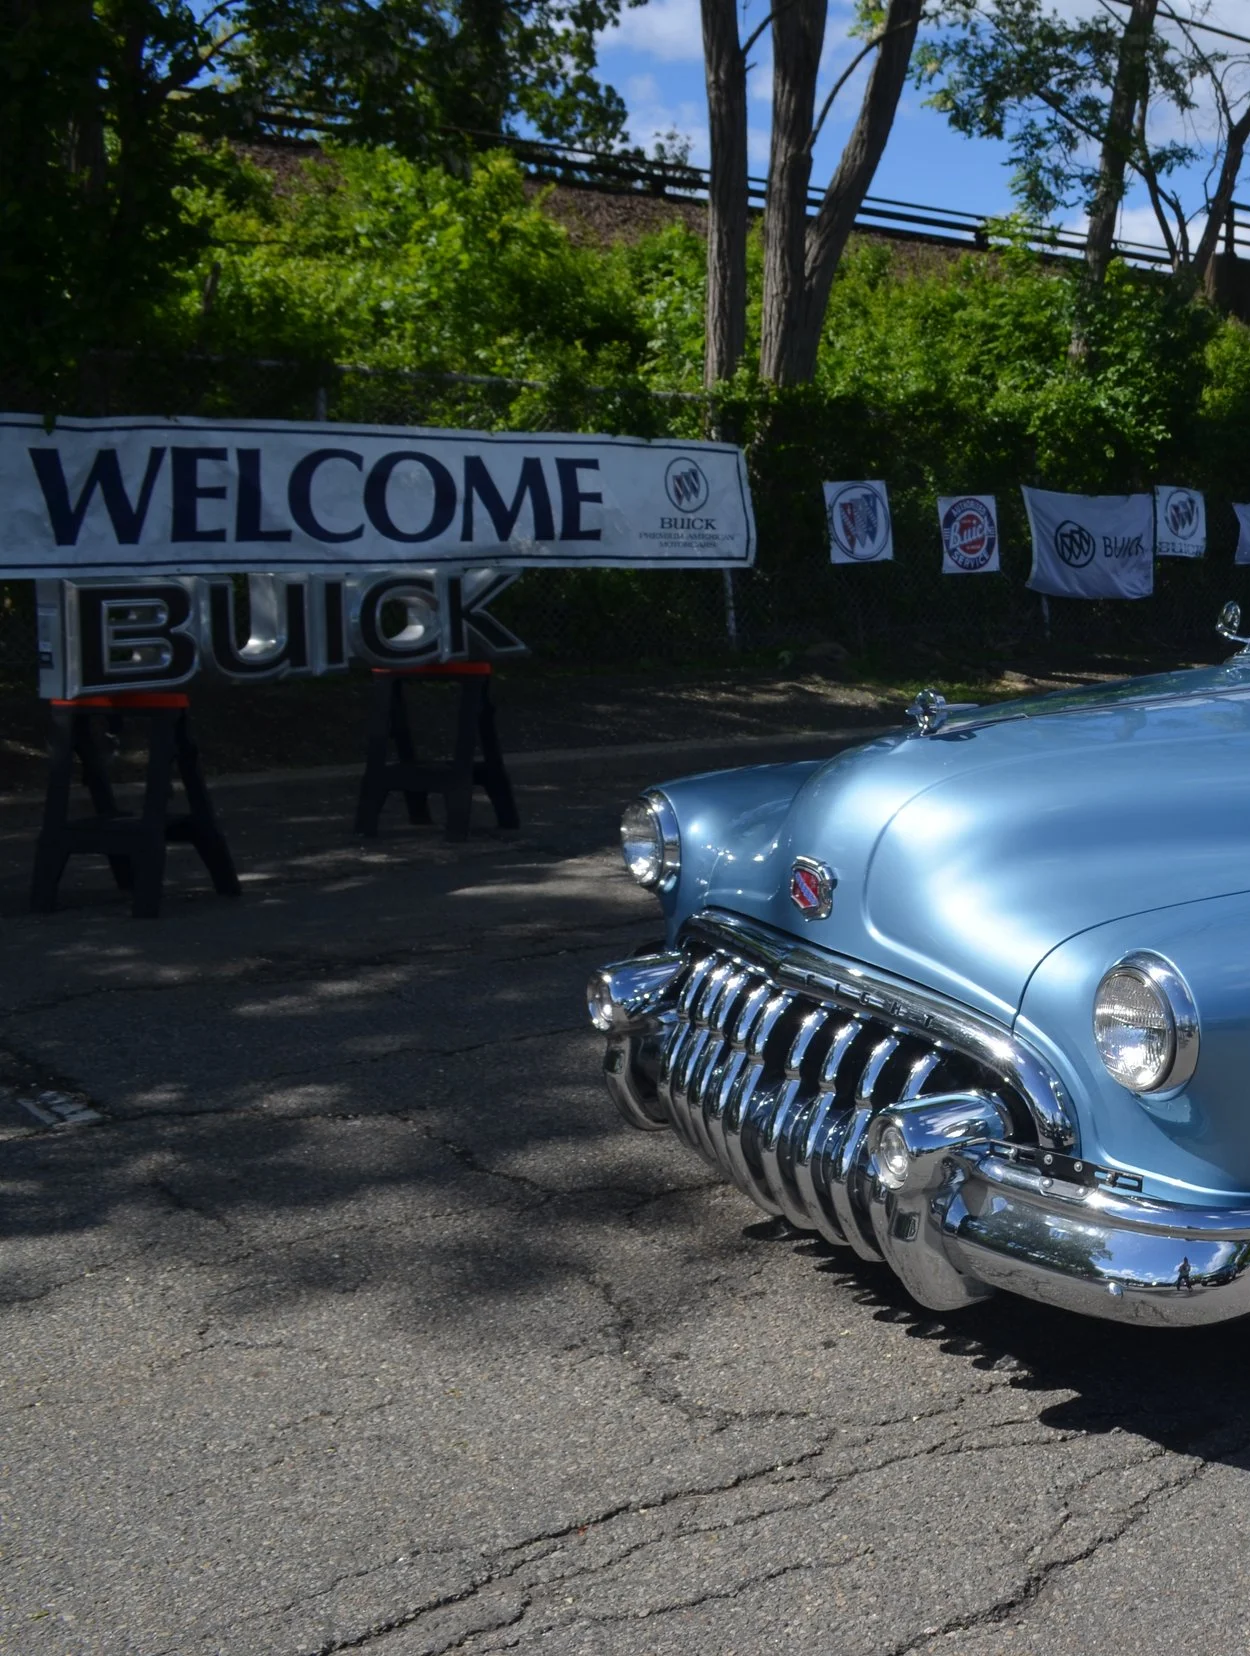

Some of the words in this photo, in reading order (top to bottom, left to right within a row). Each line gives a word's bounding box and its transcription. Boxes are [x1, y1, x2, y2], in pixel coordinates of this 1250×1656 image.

[28, 445, 602, 546] WELCOME
[660, 517, 717, 530] BUICK
[949, 516, 993, 550] Buick
[951, 548, 990, 568] SERVICE
[1102, 532, 1145, 559] BUICK
[62, 569, 531, 698] BUICK
